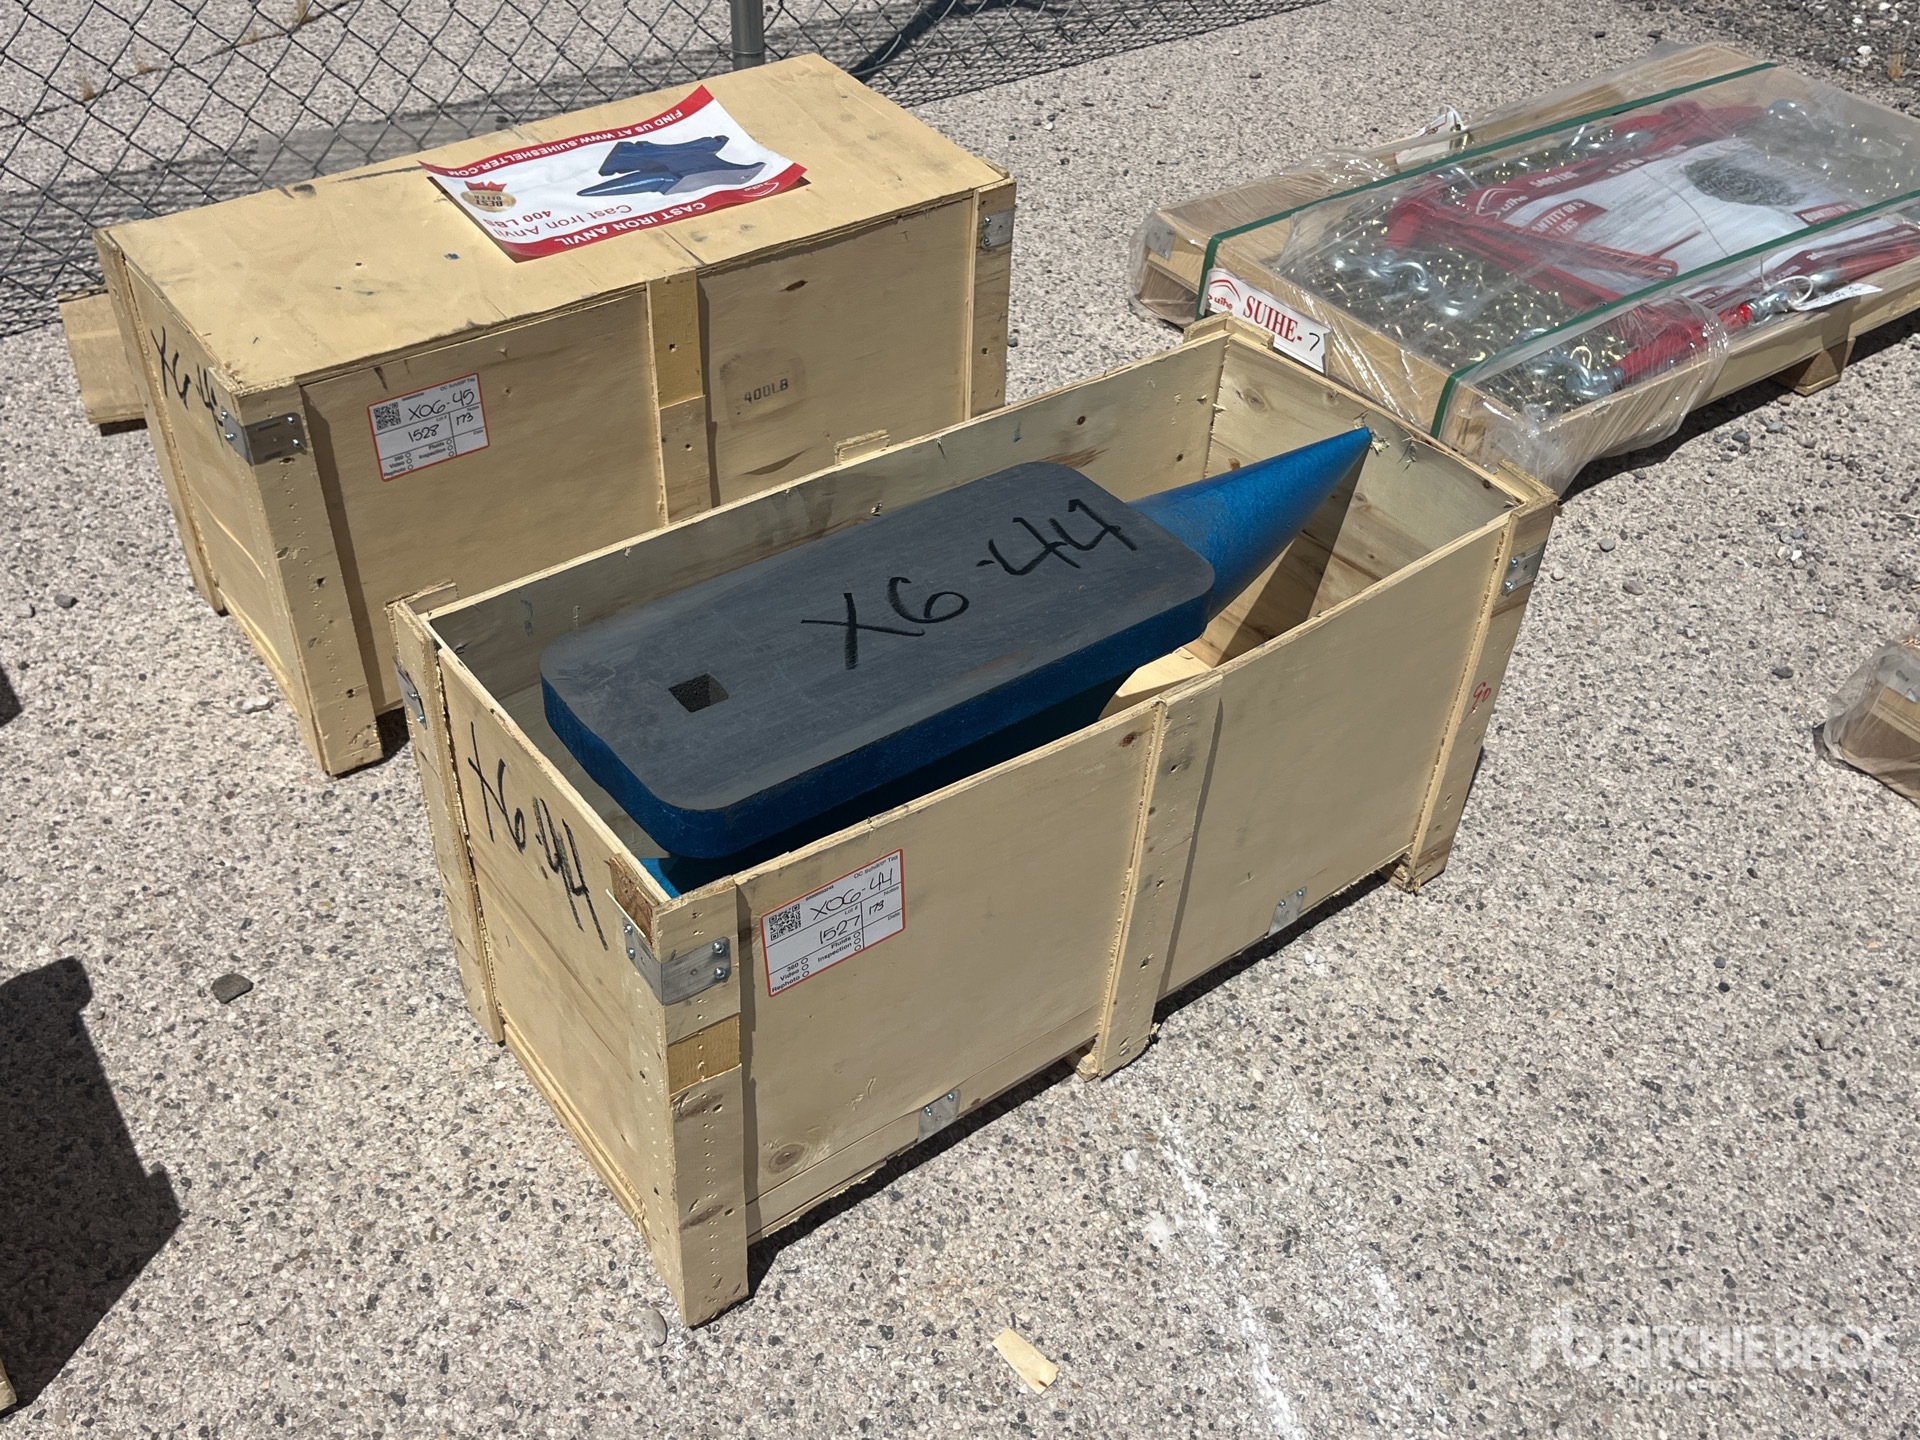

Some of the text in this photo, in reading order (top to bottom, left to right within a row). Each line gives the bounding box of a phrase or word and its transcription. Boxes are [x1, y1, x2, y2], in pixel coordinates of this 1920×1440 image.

[447, 108, 684, 177] FIND US AT WWW.SUIHESHELTER.COM
[473, 194, 502, 202] OFFER
[475, 199, 504, 208] BEST
[493, 204, 633, 239] Cast Iron Anvil
[523, 210, 553, 223] 400
[554, 201, 708, 247] CAST IRON ANVIL
[408, 424, 440, 443] 1528
[418, 447, 447, 460] Inspection
[389, 460, 405, 469] Video
[888, 854, 899, 864] Tag
[883, 885, 900, 896] Notes
[868, 899, 885, 916] 173
[887, 911, 901, 921] Date
[819, 915, 861, 945] 1527
[831, 936, 852, 950] Fluids
[817, 942, 853, 963] Inspection
[786, 962, 799, 972] 360
[780, 969, 800, 981] Video
[771, 975, 801, 993] Rephoto
